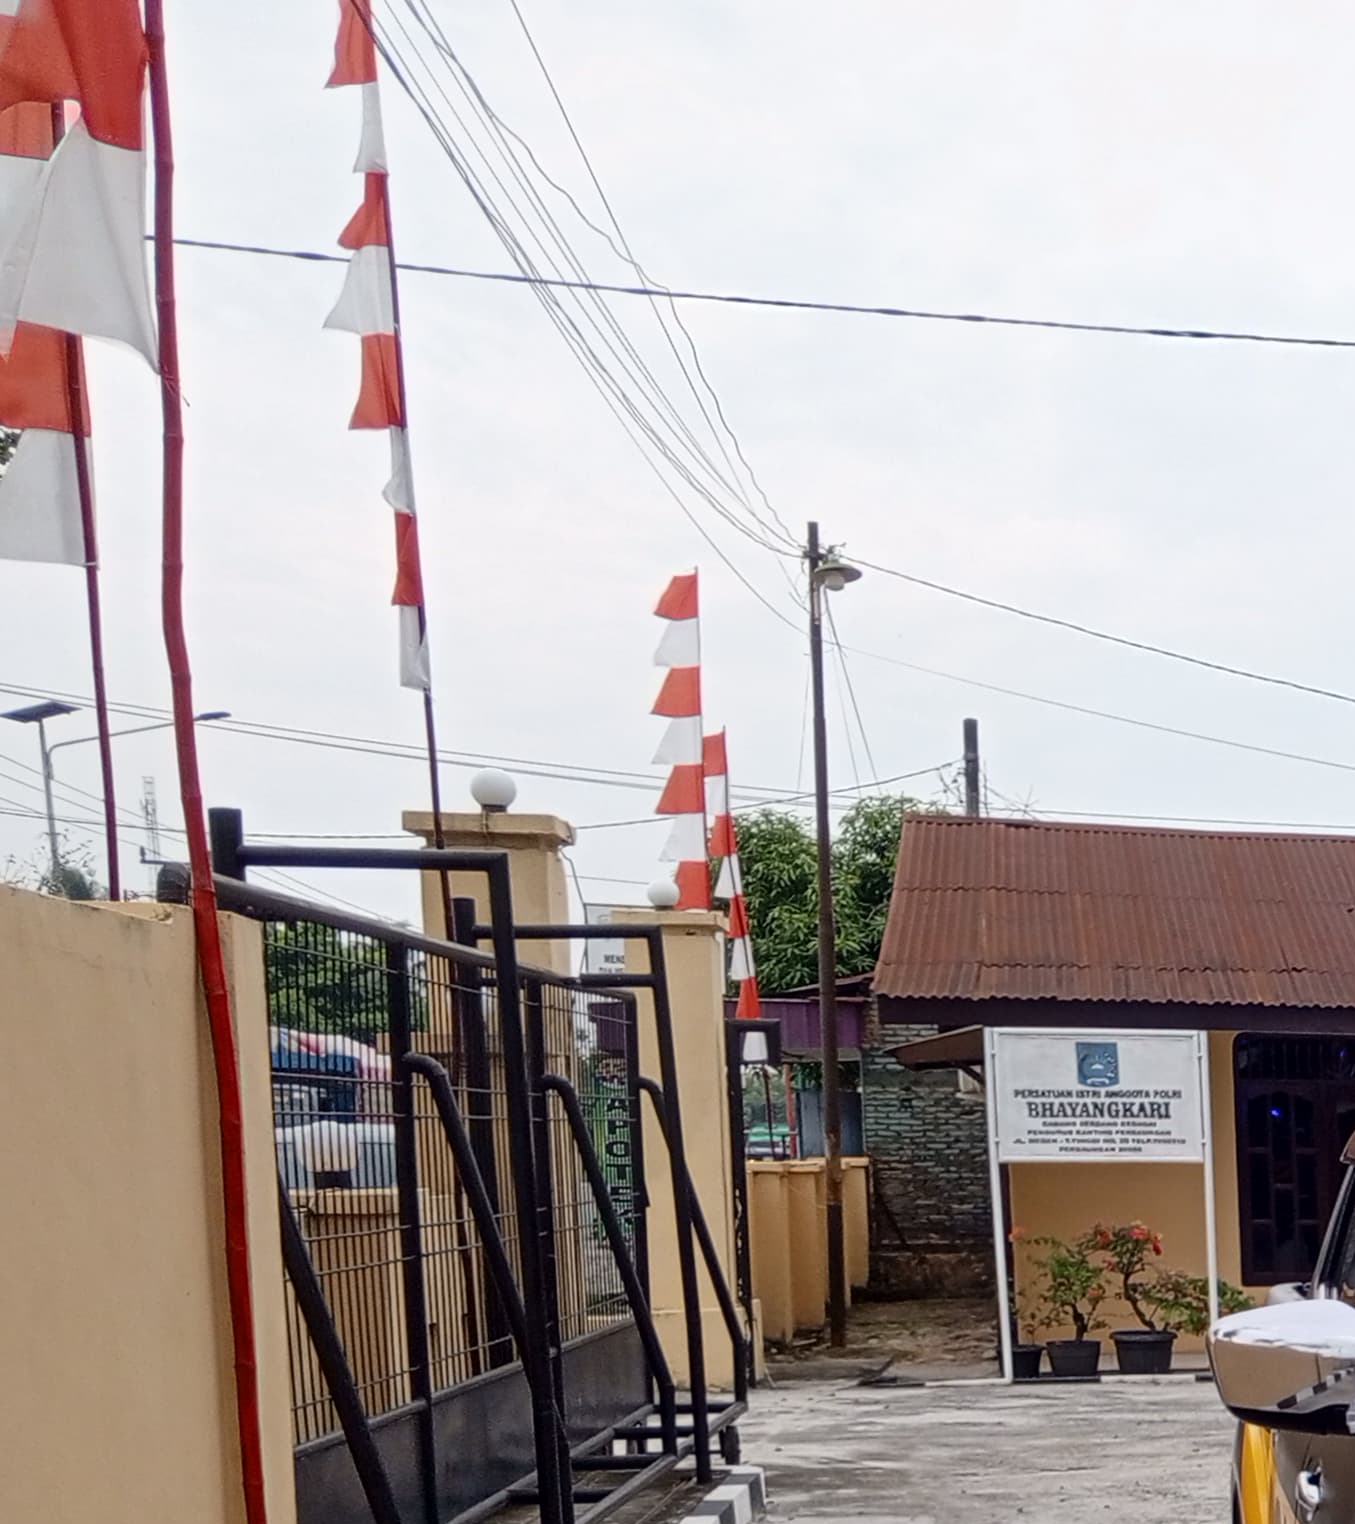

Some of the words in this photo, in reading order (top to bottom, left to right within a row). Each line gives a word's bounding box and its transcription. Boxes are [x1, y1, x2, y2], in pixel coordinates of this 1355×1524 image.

[1014, 1089, 1073, 1099] PERSATUAN
[1075, 1090, 1102, 1099] ISTRI
[1104, 1089, 1151, 1099] ANGGOTA
[1153, 1089, 1182, 1099] POLRI
[1026, 1101, 1171, 1119] BHAYANGKARI
